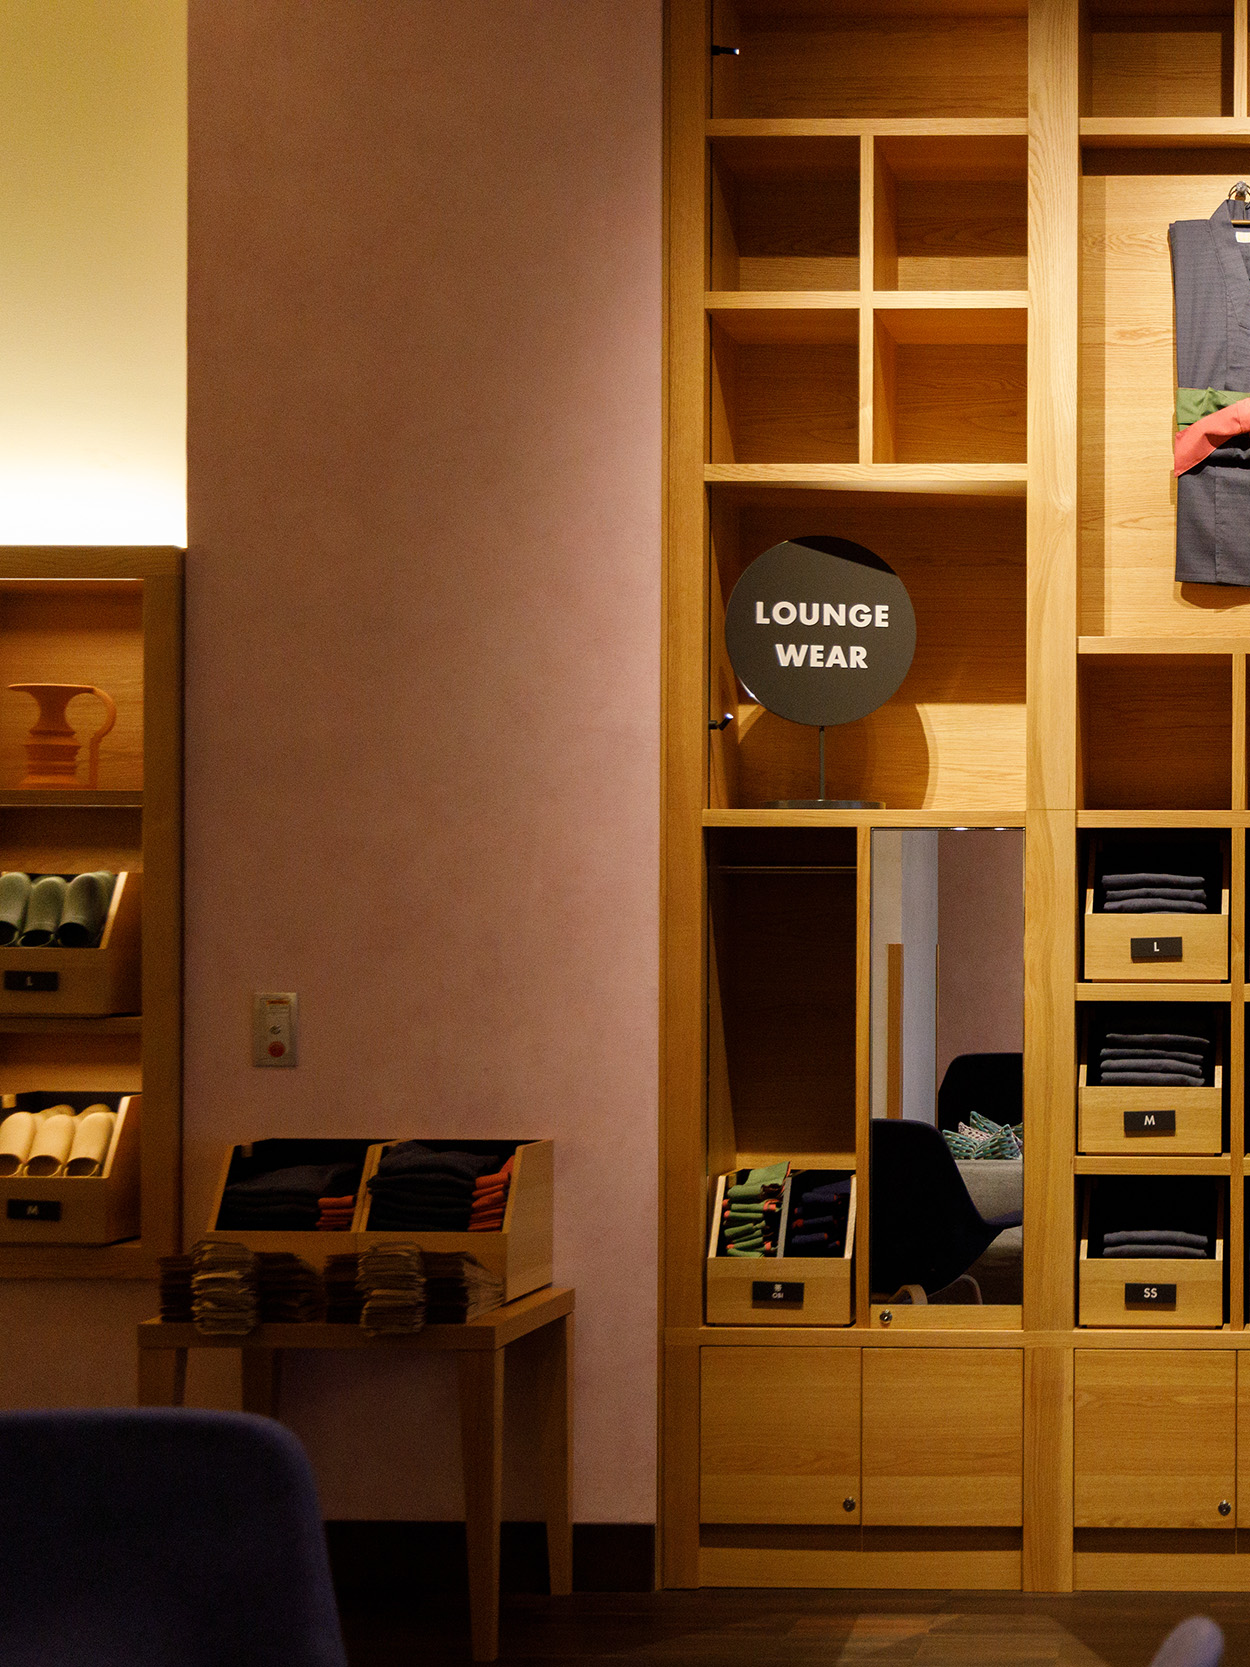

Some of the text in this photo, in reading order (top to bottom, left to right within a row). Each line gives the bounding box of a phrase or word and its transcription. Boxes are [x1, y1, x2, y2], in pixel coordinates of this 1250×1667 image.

[755, 601, 889, 628] LOUNGE
[775, 643, 868, 669] WEAR
[1153, 941, 1160, 952] L
[1143, 1115, 1156, 1126] M
[1143, 1287, 1158, 1299] SS
